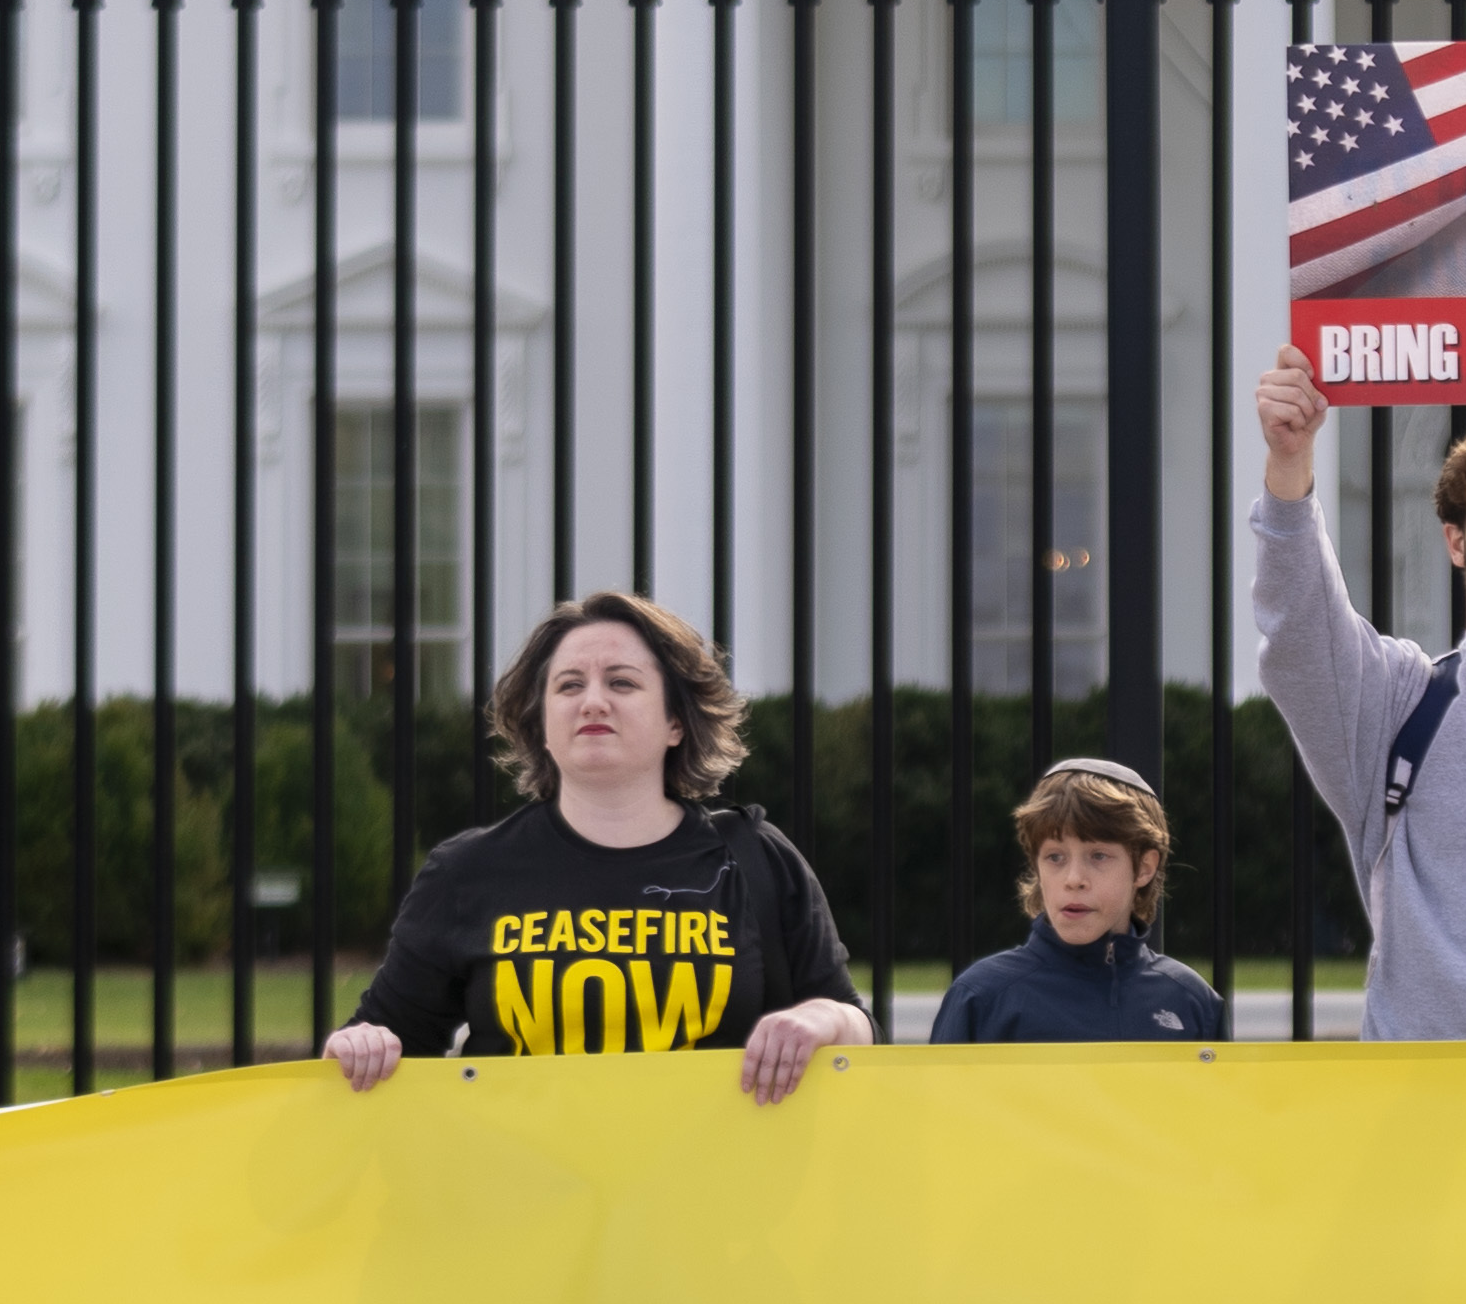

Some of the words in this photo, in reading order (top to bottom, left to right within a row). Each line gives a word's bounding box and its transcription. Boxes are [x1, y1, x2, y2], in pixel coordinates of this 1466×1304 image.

[1320, 323, 1459, 383] BRING
[492, 908, 736, 956] CEASEFIRE
[495, 958, 733, 1057] NOW
